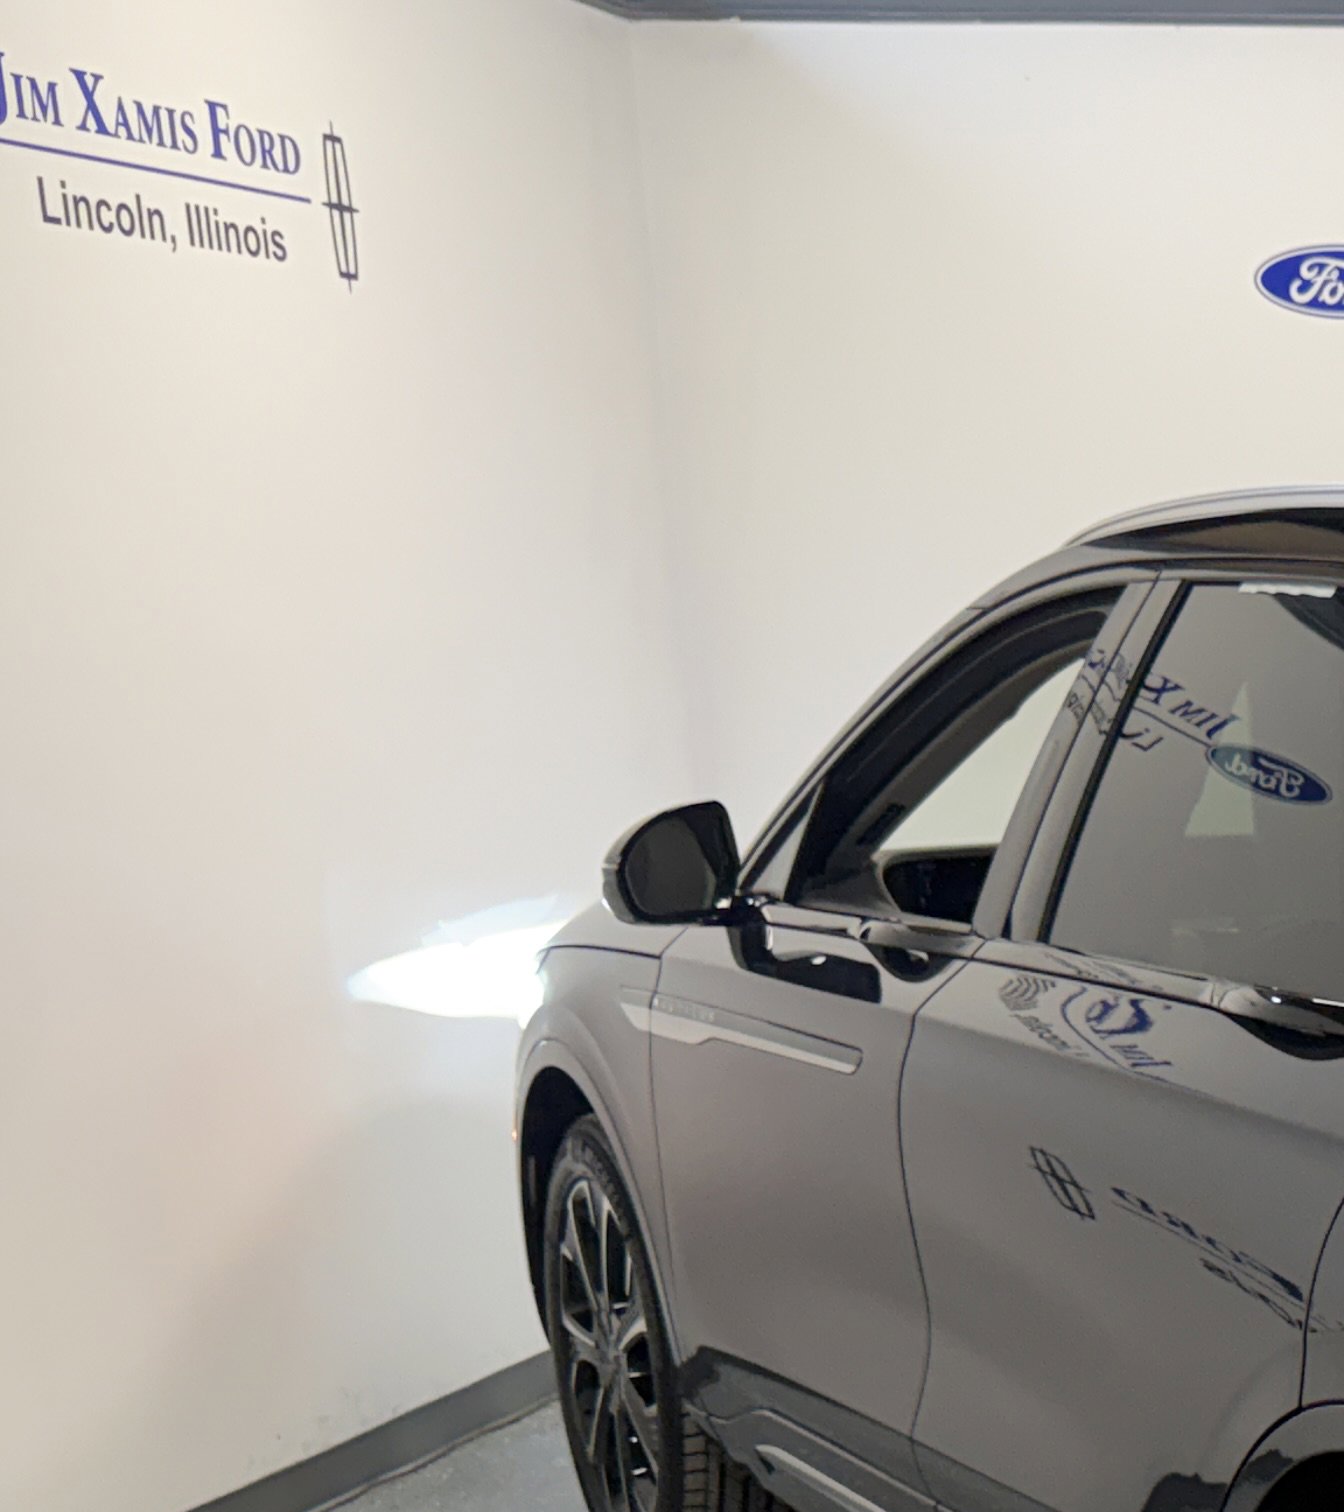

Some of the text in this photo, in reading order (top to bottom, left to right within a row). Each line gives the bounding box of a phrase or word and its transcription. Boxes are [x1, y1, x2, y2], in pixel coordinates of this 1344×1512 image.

[69, 68, 198, 154] XAMIS
[204, 99, 300, 175] FORD
[37, 176, 287, 264] Lincoln, Illinois
